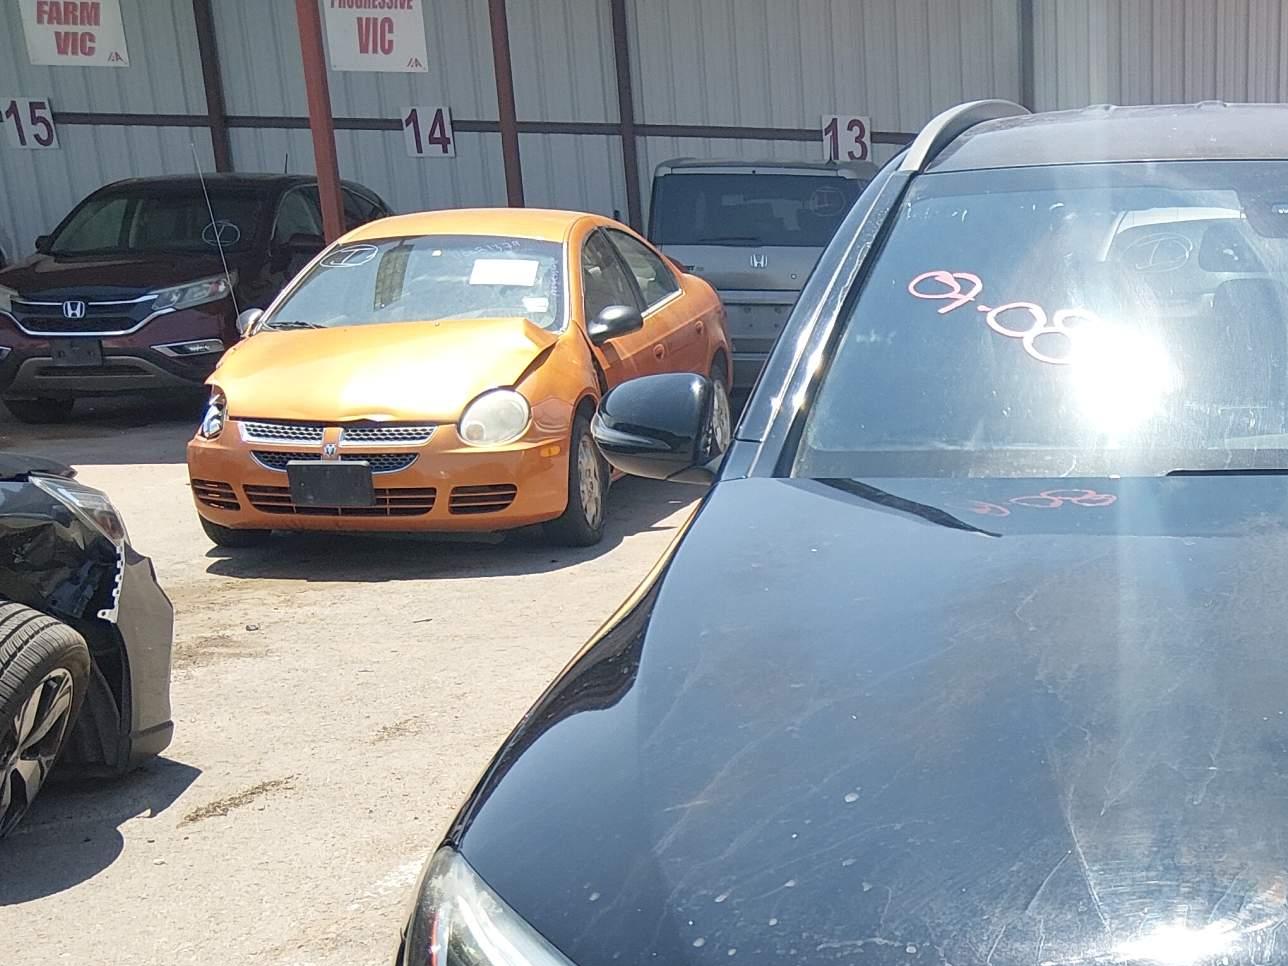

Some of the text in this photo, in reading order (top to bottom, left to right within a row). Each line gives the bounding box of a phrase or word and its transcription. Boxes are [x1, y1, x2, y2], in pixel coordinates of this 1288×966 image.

[36, 1, 101, 26] FARM
[54, 31, 96, 56] VIC
[356, 17, 394, 55] VIC
[5, 100, 54, 147] 15
[405, 108, 451, 154] 14
[824, 118, 868, 161] 13
